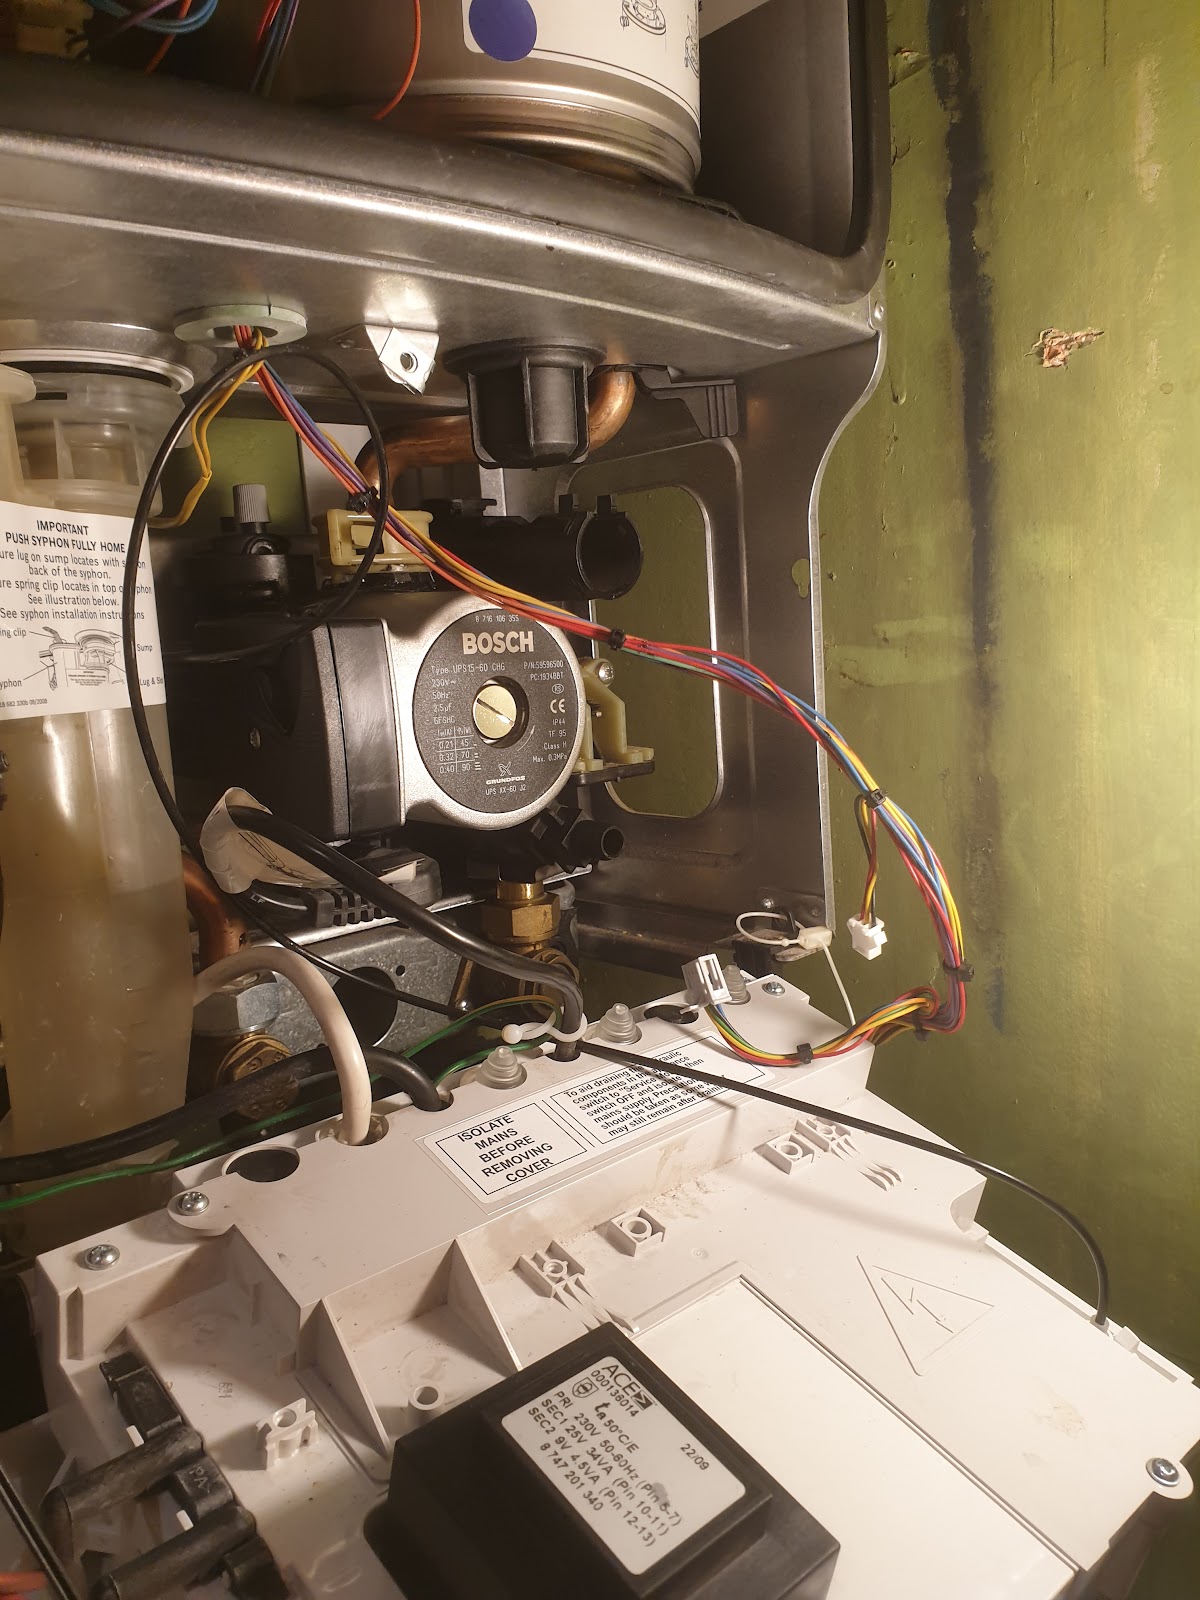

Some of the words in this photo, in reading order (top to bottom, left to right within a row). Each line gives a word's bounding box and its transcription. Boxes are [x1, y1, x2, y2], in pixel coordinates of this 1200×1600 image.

[37, 519, 89, 536] IMPORTANT
[5, 531, 29, 545] PUSH
[31, 535, 70, 549] SYPHON
[71, 538, 96, 552] FULLY
[100, 541, 126, 553] HOME
[17, 549, 29, 563] lug
[31, 553, 41, 562] on
[44, 554, 69, 565] sump
[71, 554, 99, 567] locates
[102, 557, 120, 568] with
[28, 564, 49, 576] back
[51, 566, 60, 577] of
[64, 566, 78, 577] the
[80, 569, 111, 581] syphon.
[15, 579, 40, 593] spring
[42, 579, 59, 593] clip
[61, 580, 90, 592] locates
[91, 582, 99, 592] in
[102, 583, 117, 594] top
[28, 593, 43, 604] See
[45, 594, 91, 606] illustration
[92, 595, 120, 606] below.
[0, 607, 17, 619] See
[20, 608, 50, 621] syphon
[51, 608, 98, 619] installation
[13, 626, 27, 638] clip
[462, 630, 534, 655] BOSCH
[136, 643, 153, 652] Sump
[550, 698, 566, 714] CE
[558, 729, 567, 737] 95
[438, 740, 454, 750] 0.21
[439, 752, 454, 762] 0.32
[461, 750, 470, 759] 70
[543, 742, 560, 750] Class
[439, 764, 455, 774] 0.40
[461, 763, 471, 772] 90
[485, 775, 526, 785] GRUNDFOS
[485, 787, 497, 796] UPS
[563, 1090, 578, 1098] To
[578, 1083, 593, 1093] aid
[593, 1070, 631, 1087] draining
[628, 1064, 644, 1074] the
[572, 1080, 627, 1104] components
[624, 1075, 637, 1083] in
[579, 1095, 610, 1110] switch
[618, 1077, 657, 1092] "Service
[683, 1058, 704, 1068] then
[586, 1101, 617, 1116] switch
[615, 1092, 635, 1104] OFF
[636, 1085, 654, 1097] and
[651, 1075, 682, 1090] isolate
[600, 1112, 633, 1130] should
[630, 1108, 646, 1116] be
[644, 1098, 670, 1111] taken
[669, 1093, 681, 1101] as
[680, 1084, 705, 1096] some
[593, 1109, 622, 1124] mains
[621, 1096, 655, 1114] supply.
[607, 1124, 629, 1136] may
[628, 1115, 647, 1127] still
[646, 1104, 677, 1120] remain
[676, 1095, 696, 1107] after
[457, 1115, 514, 1142] ISOLATE
[474, 1128, 518, 1150] MAINS
[478, 1135, 535, 1163] BEFORE
[481, 1142, 553, 1177] REMOVING
[505, 1157, 554, 1182] COVER
[590, 1369, 640, 1417] 000136014
[553, 1390, 574, 1409] PRI
[573, 1412, 601, 1436] 230V
[599, 1439, 639, 1481] 50-60Hz
[635, 1479, 660, 1503] (Pin
[679, 1443, 710, 1470] 22/09
[528, 1407, 556, 1435] SEC2
[554, 1436, 573, 1450] 9V
[570, 1454, 600, 1485] 4.5VA
[598, 1486, 622, 1511] (Pin
[622, 1510, 656, 1547] 12-13)
[540, 1442, 551, 1451] 8
[547, 1449, 569, 1469] 747
[563, 1470, 585, 1490] 201
[582, 1490, 604, 1511] 340
[541, 1398, 568, 1425] SEC1
[564, 1424, 588, 1443] 25V
[585, 1446, 613, 1476] 34VA
[611, 1477, 635, 1501] (Pin
[635, 1500, 669, 1536] 10-11)
